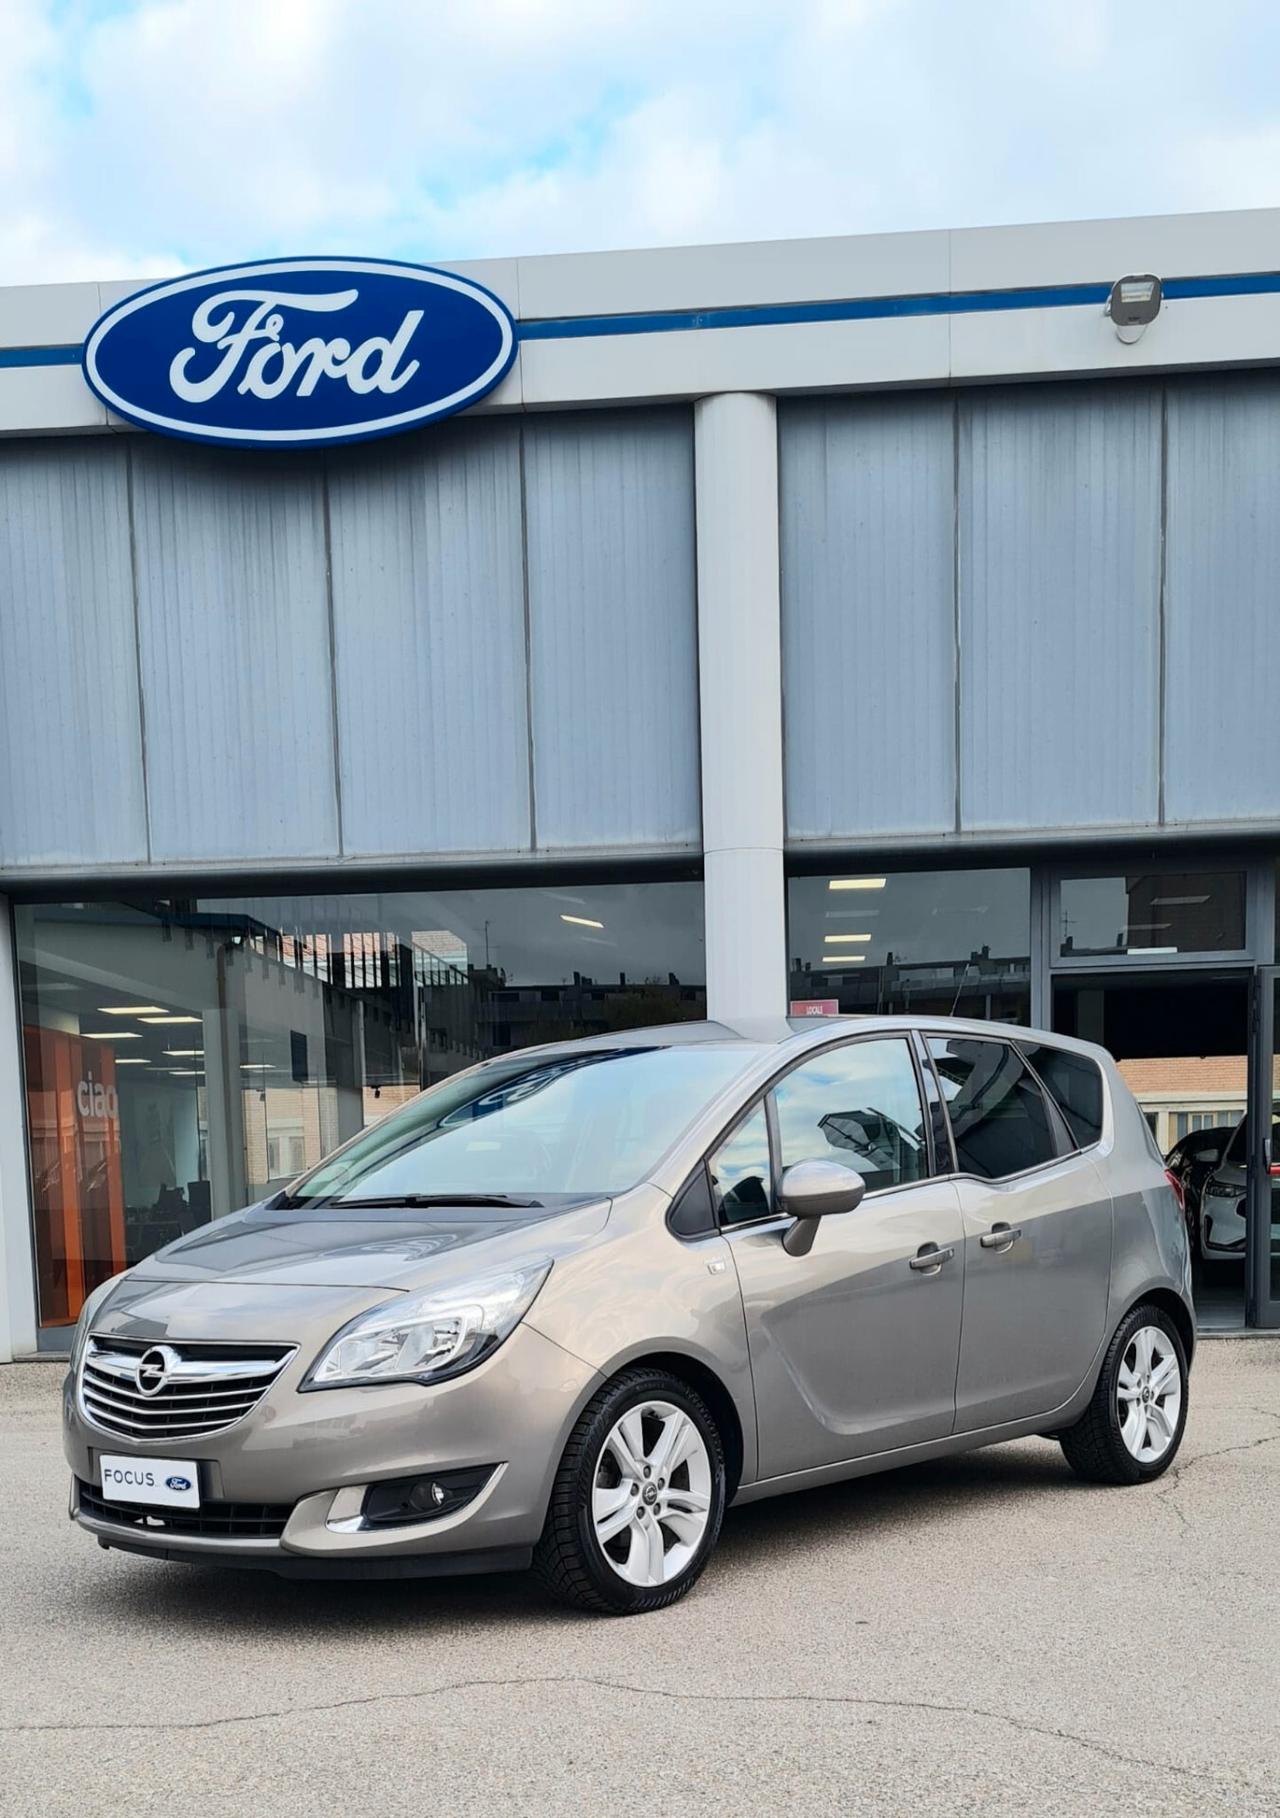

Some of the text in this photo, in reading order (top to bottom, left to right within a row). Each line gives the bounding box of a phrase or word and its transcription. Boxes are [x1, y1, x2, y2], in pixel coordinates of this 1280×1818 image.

[169, 289, 424, 403] Ford
[77, 1071, 118, 1118] ciao
[104, 1469, 155, 1487] FOCUS
